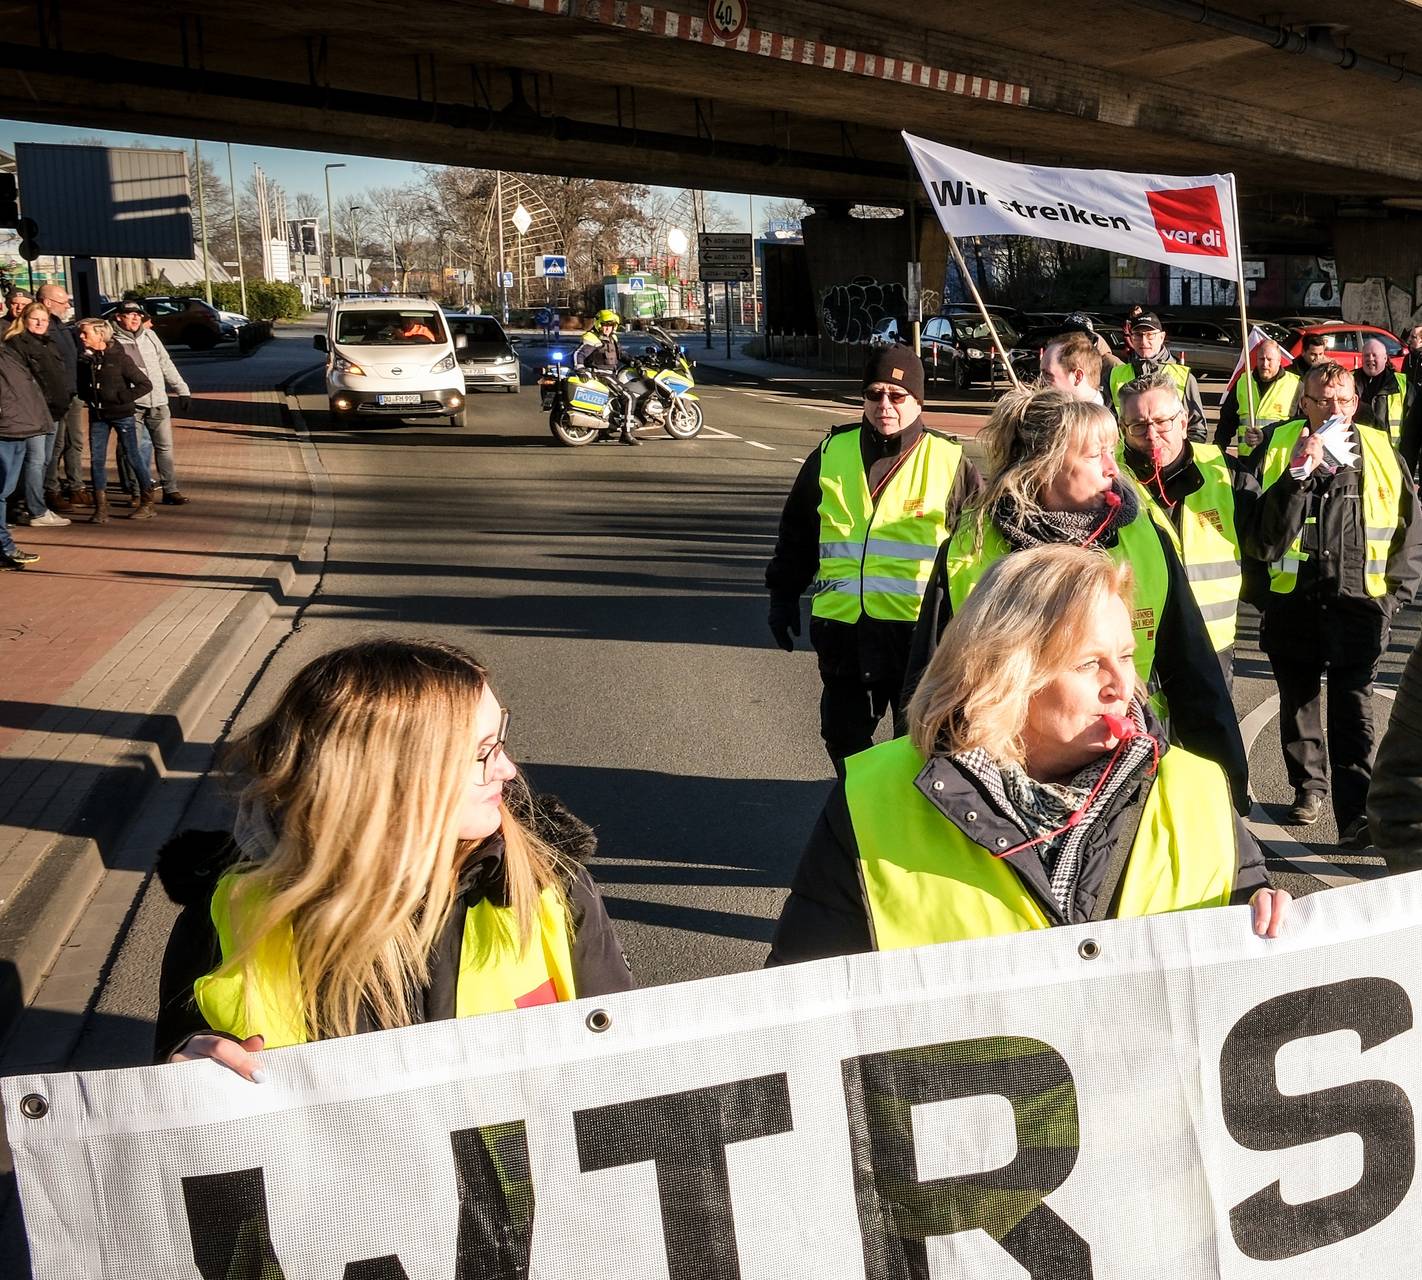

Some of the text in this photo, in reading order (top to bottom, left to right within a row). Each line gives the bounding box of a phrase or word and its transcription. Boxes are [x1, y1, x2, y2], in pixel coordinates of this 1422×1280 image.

[930, 179, 1132, 232] Wir streiken
[576, 390, 605, 405] POLIZEI
